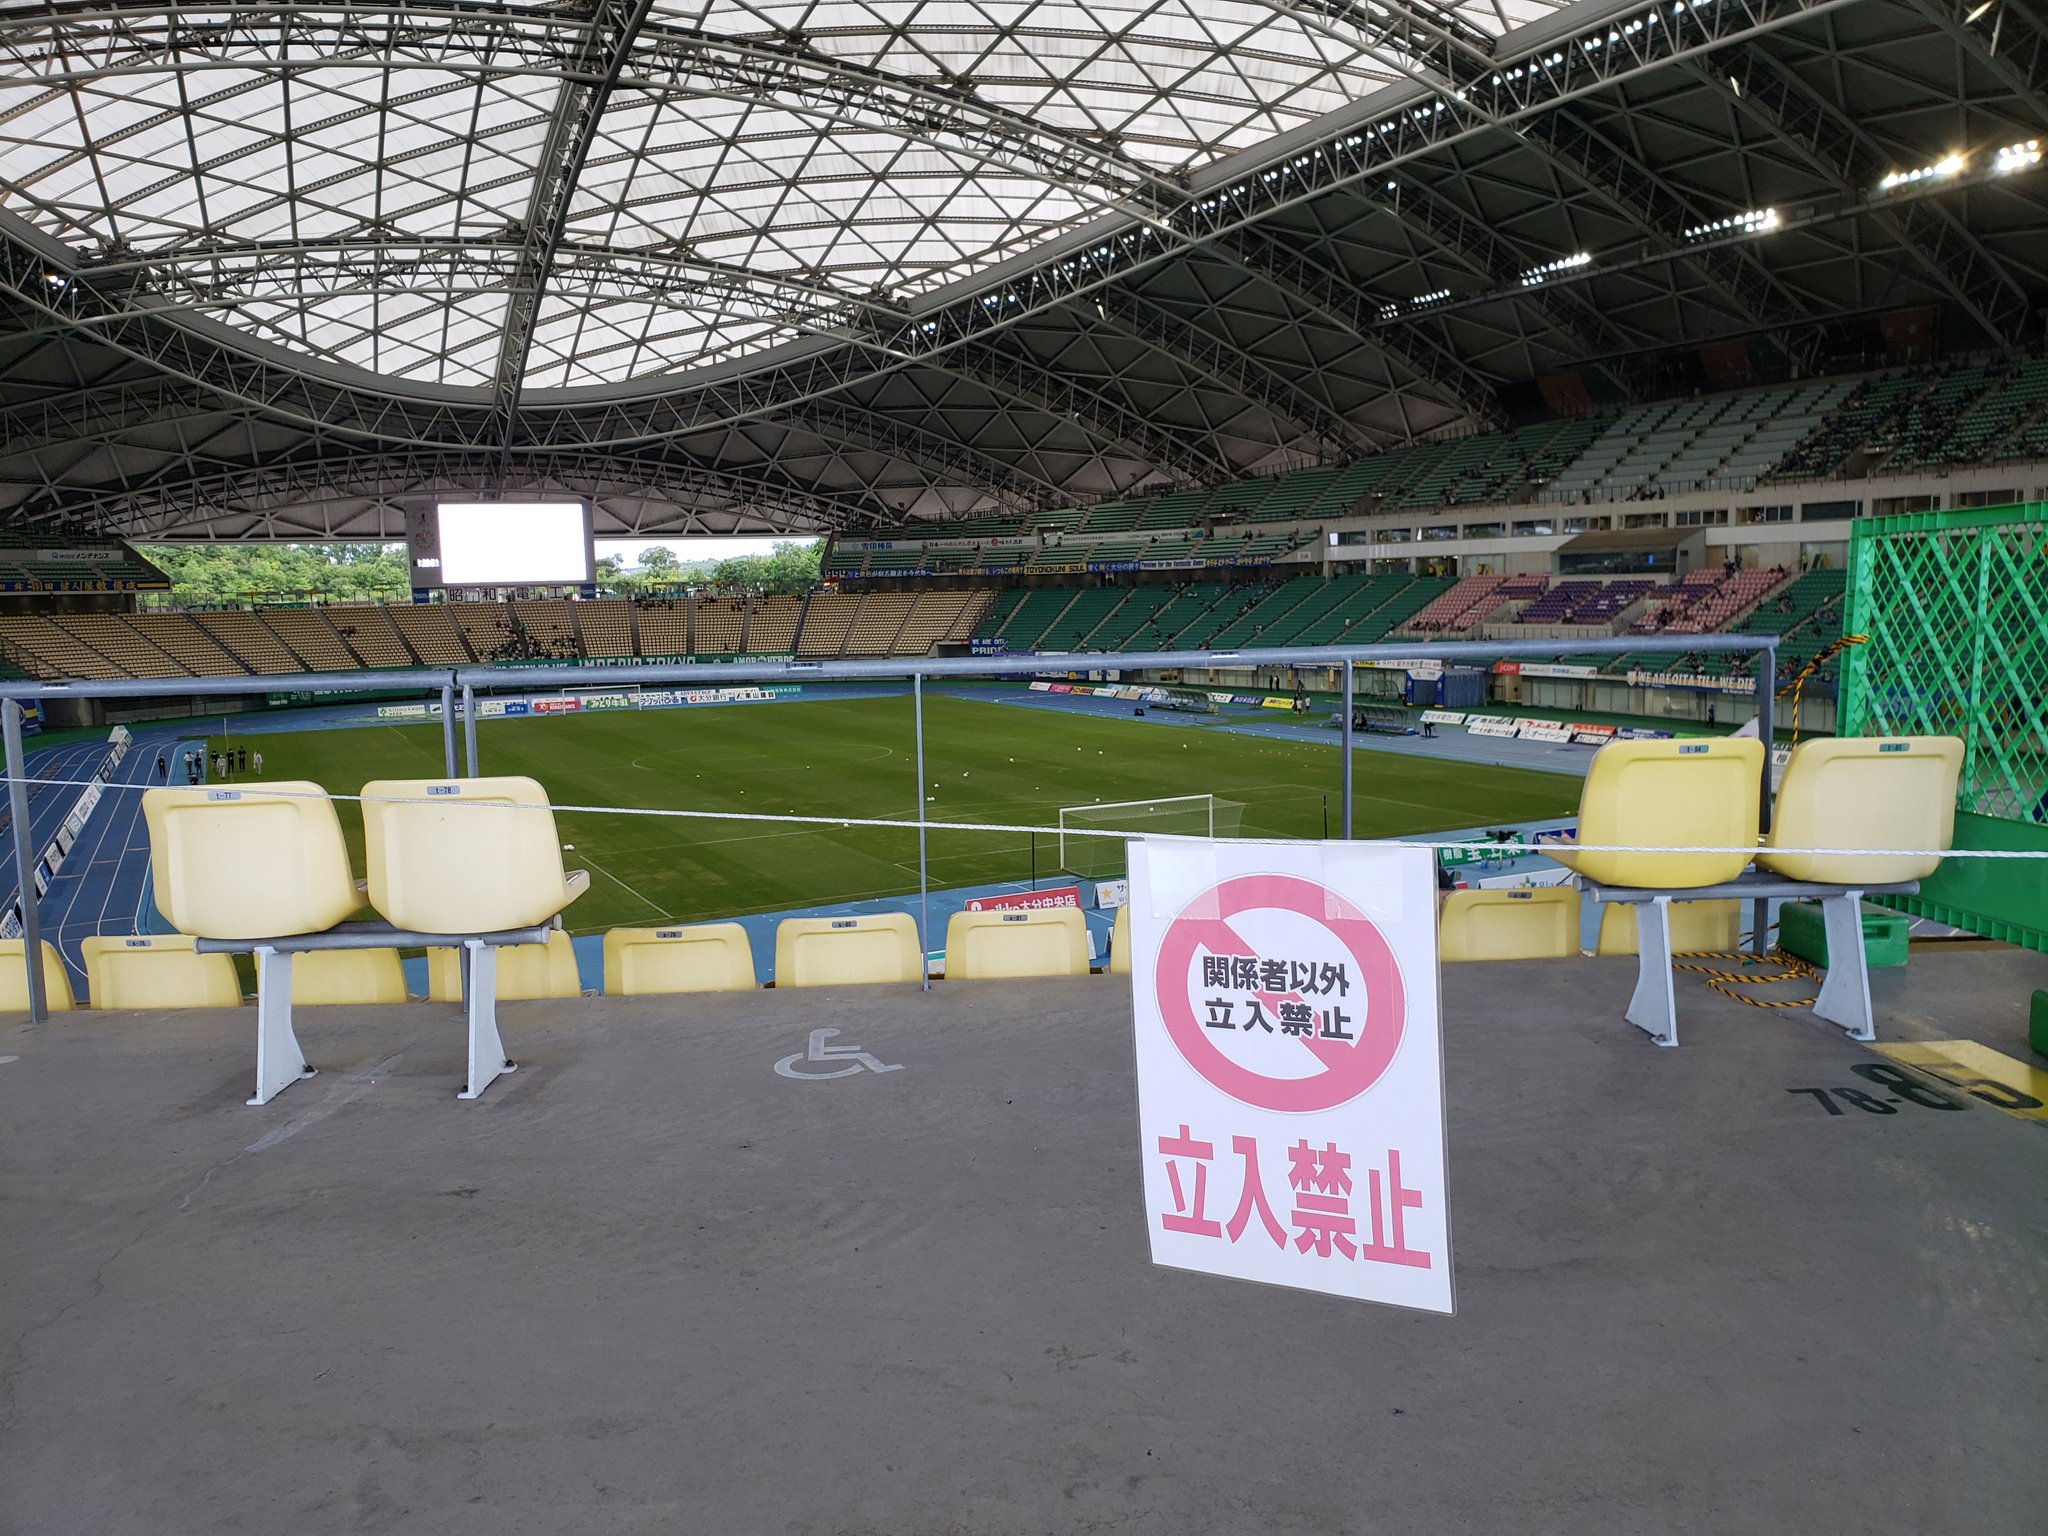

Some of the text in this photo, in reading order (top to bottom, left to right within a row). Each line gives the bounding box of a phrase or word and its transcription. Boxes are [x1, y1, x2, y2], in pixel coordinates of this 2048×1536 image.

[1026, 566, 1066, 574] TOYONOKUNI
[449, 586, 564, 602] 昭和電工
[1637, 670, 1652, 684] WE
[1652, 671, 1672, 685] ARE
[1672, 672, 1696, 687] OITA
[1697, 675, 1717, 688] TILL
[1719, 677, 1737, 690] WE
[1736, 677, 1757, 690] DIE
[698, 693, 727, 702] 大分銀行
[215, 791, 233, 801] t-77
[434, 785, 453, 796] t-78
[1202, 955, 1350, 997] 関係者以外
[1204, 997, 1354, 1040] 立入禁止
[1157, 1123, 1432, 1270] 立入禁止
